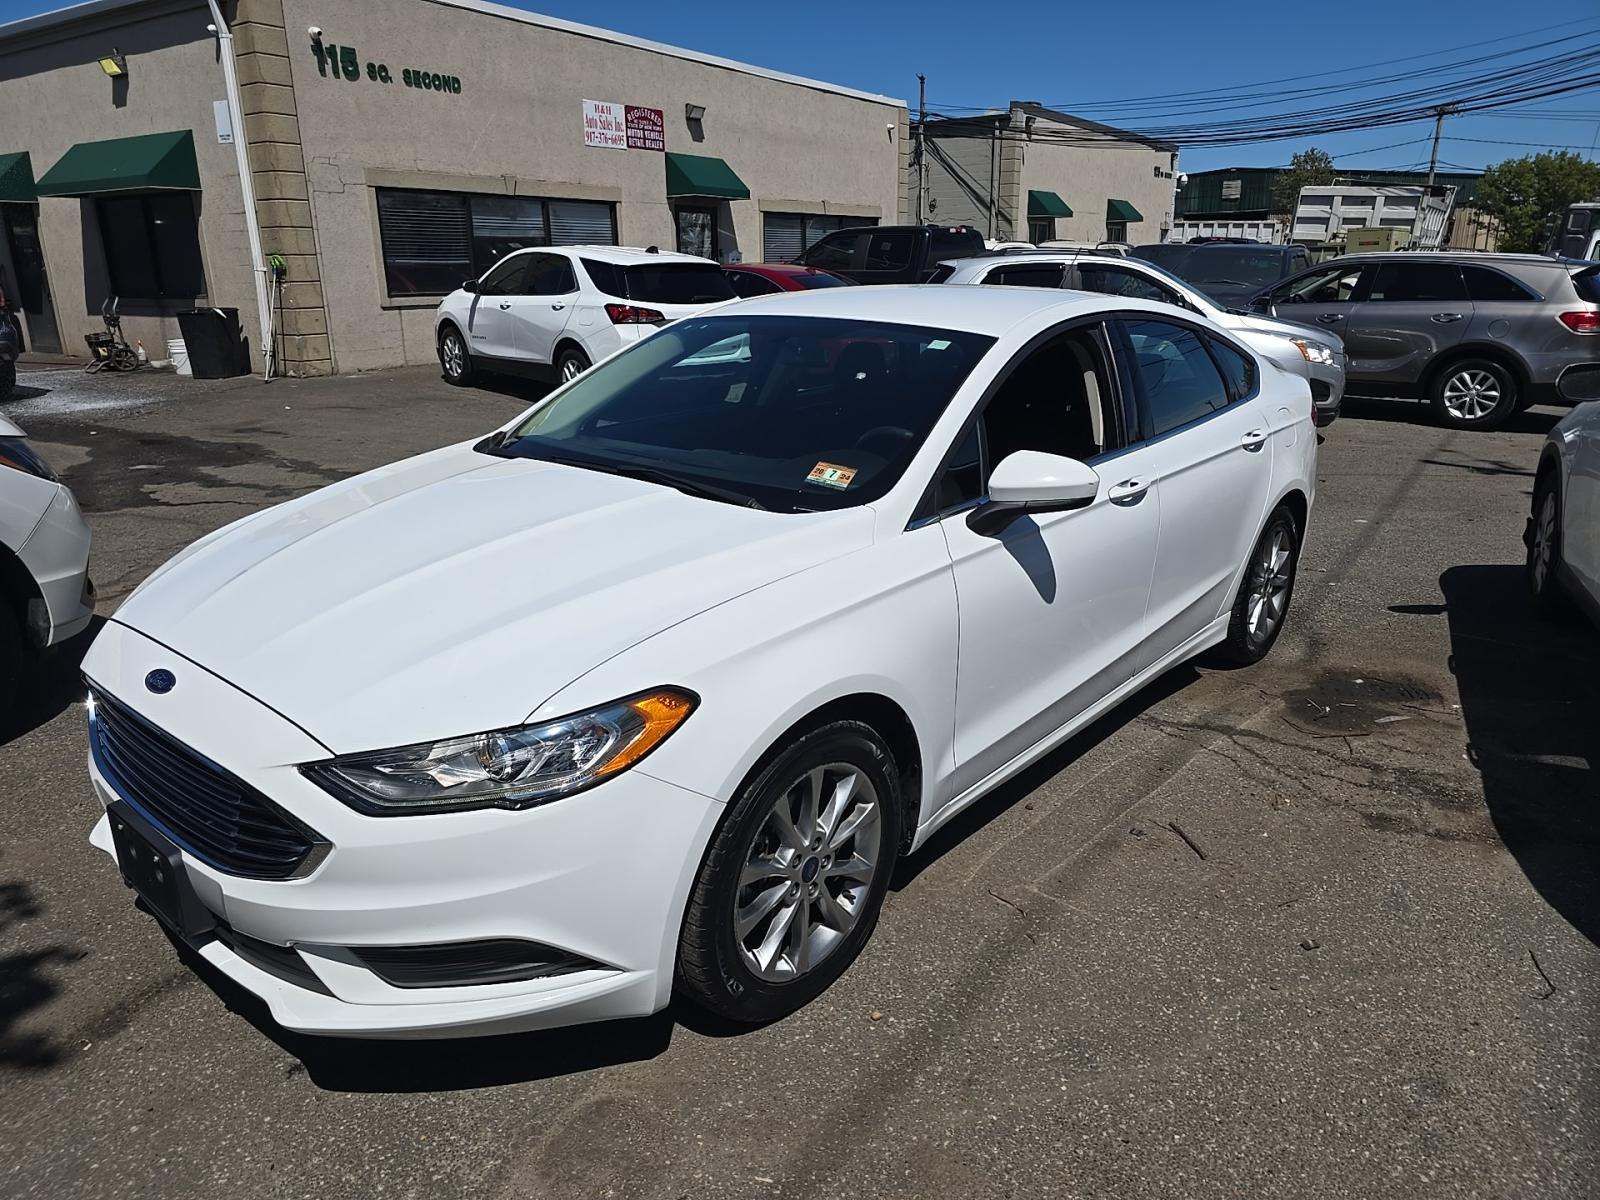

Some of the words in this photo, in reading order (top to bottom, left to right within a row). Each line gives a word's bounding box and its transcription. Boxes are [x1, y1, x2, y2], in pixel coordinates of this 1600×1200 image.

[311, 43, 360, 82] 115
[402, 68, 462, 94] SECOND
[586, 114, 598, 129] Auto
[599, 115, 613, 131] Sales
[627, 109, 662, 126] REGISTERED
[627, 128, 643, 138] MOTOR
[645, 130, 664, 141] VEHICLE
[629, 138, 645, 147] RETAIL
[645, 139, 664, 149] DEALER
[829, 470, 837, 478] 7
